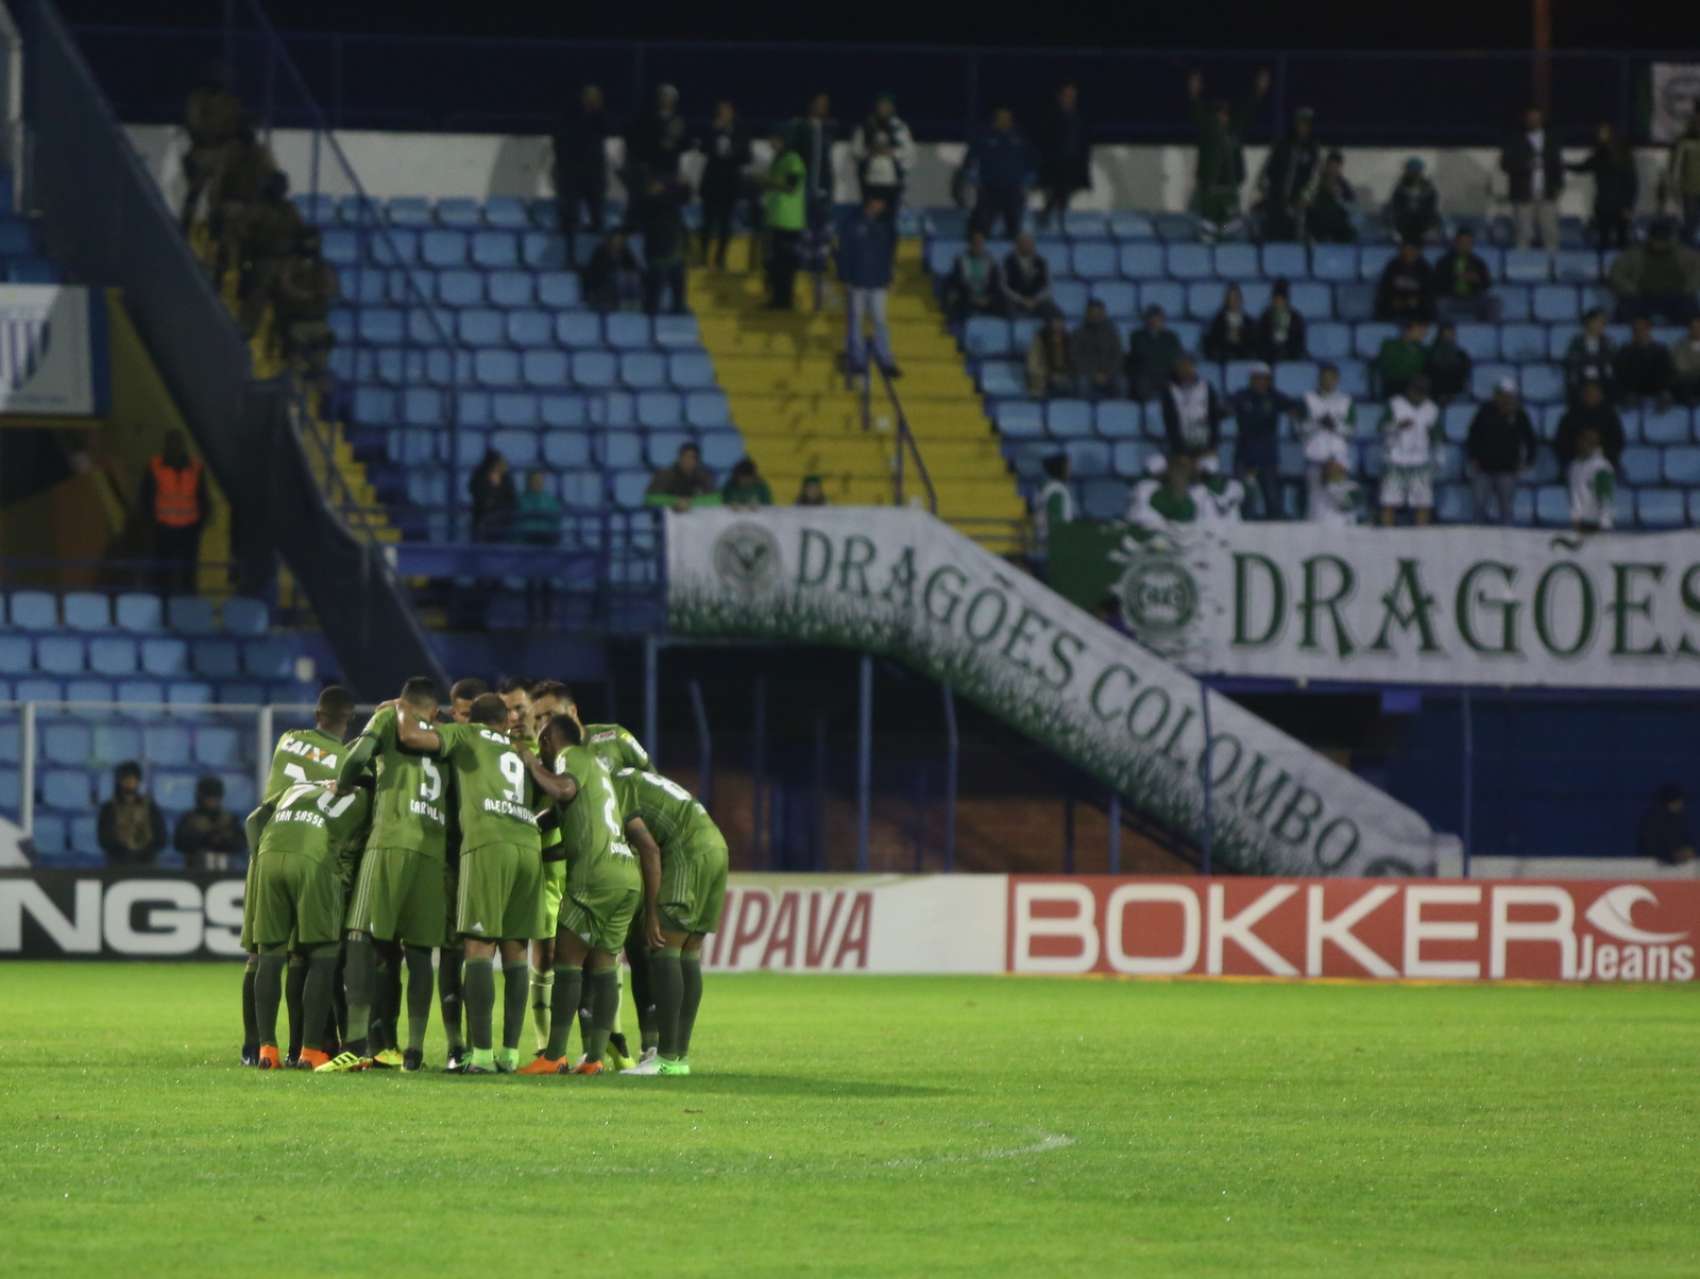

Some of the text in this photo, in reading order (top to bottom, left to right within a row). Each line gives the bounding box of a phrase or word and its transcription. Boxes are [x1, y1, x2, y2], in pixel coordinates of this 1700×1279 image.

[280, 735, 338, 769] CAIXA
[420, 756, 442, 801] 5
[499, 751, 525, 805] 9
[1090, 662, 1361, 872] COLOMBO
[703, 890, 874, 969] IPAVA
[1013, 882, 1578, 980] BOKKER
[1576, 933, 1695, 982] Jeans
